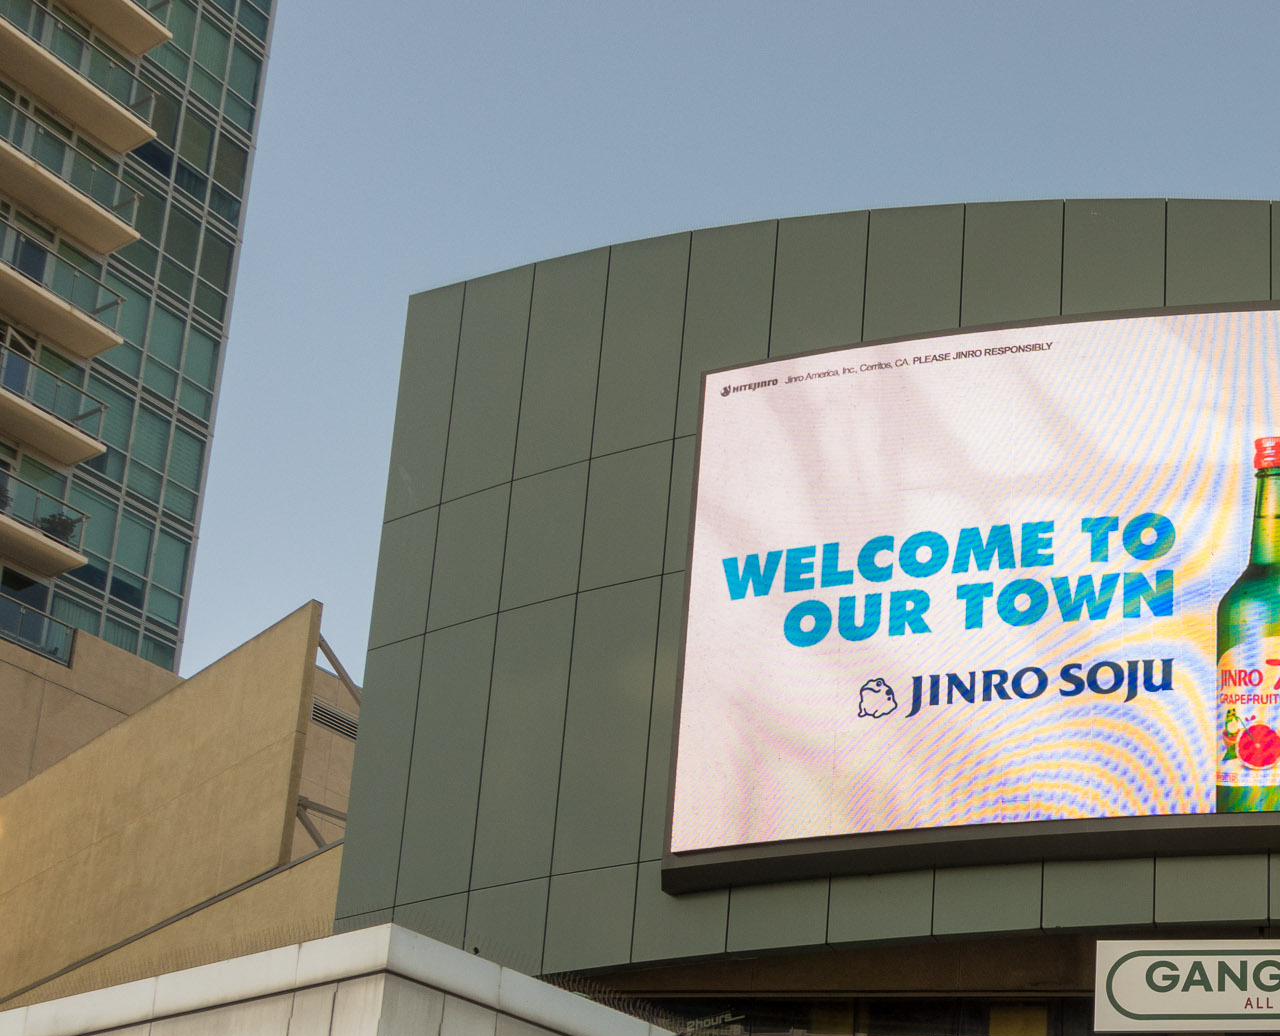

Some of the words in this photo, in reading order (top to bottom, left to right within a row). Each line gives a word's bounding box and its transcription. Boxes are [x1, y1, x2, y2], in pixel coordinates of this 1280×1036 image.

[785, 375, 804, 385] Jinro
[860, 360, 893, 373] Cerritos,
[913, 352, 951, 365] PLEASE
[953, 349, 982, 360] JINRO
[984, 342, 1053, 356] RESPONSIBLY
[722, 520, 1054, 600] WELCOME
[1082, 512, 1175, 562] TO
[784, 588, 930, 647] OUR
[956, 570, 1174, 629] TOWN
[905, 666, 1047, 718] JINRO
[1059, 658, 1175, 703] SOJU
[1220, 693, 1279, 704] GRAPEFRUIT
[1221, 669, 1263, 690] JINRO
[1245, 997, 1274, 1009] ALL
